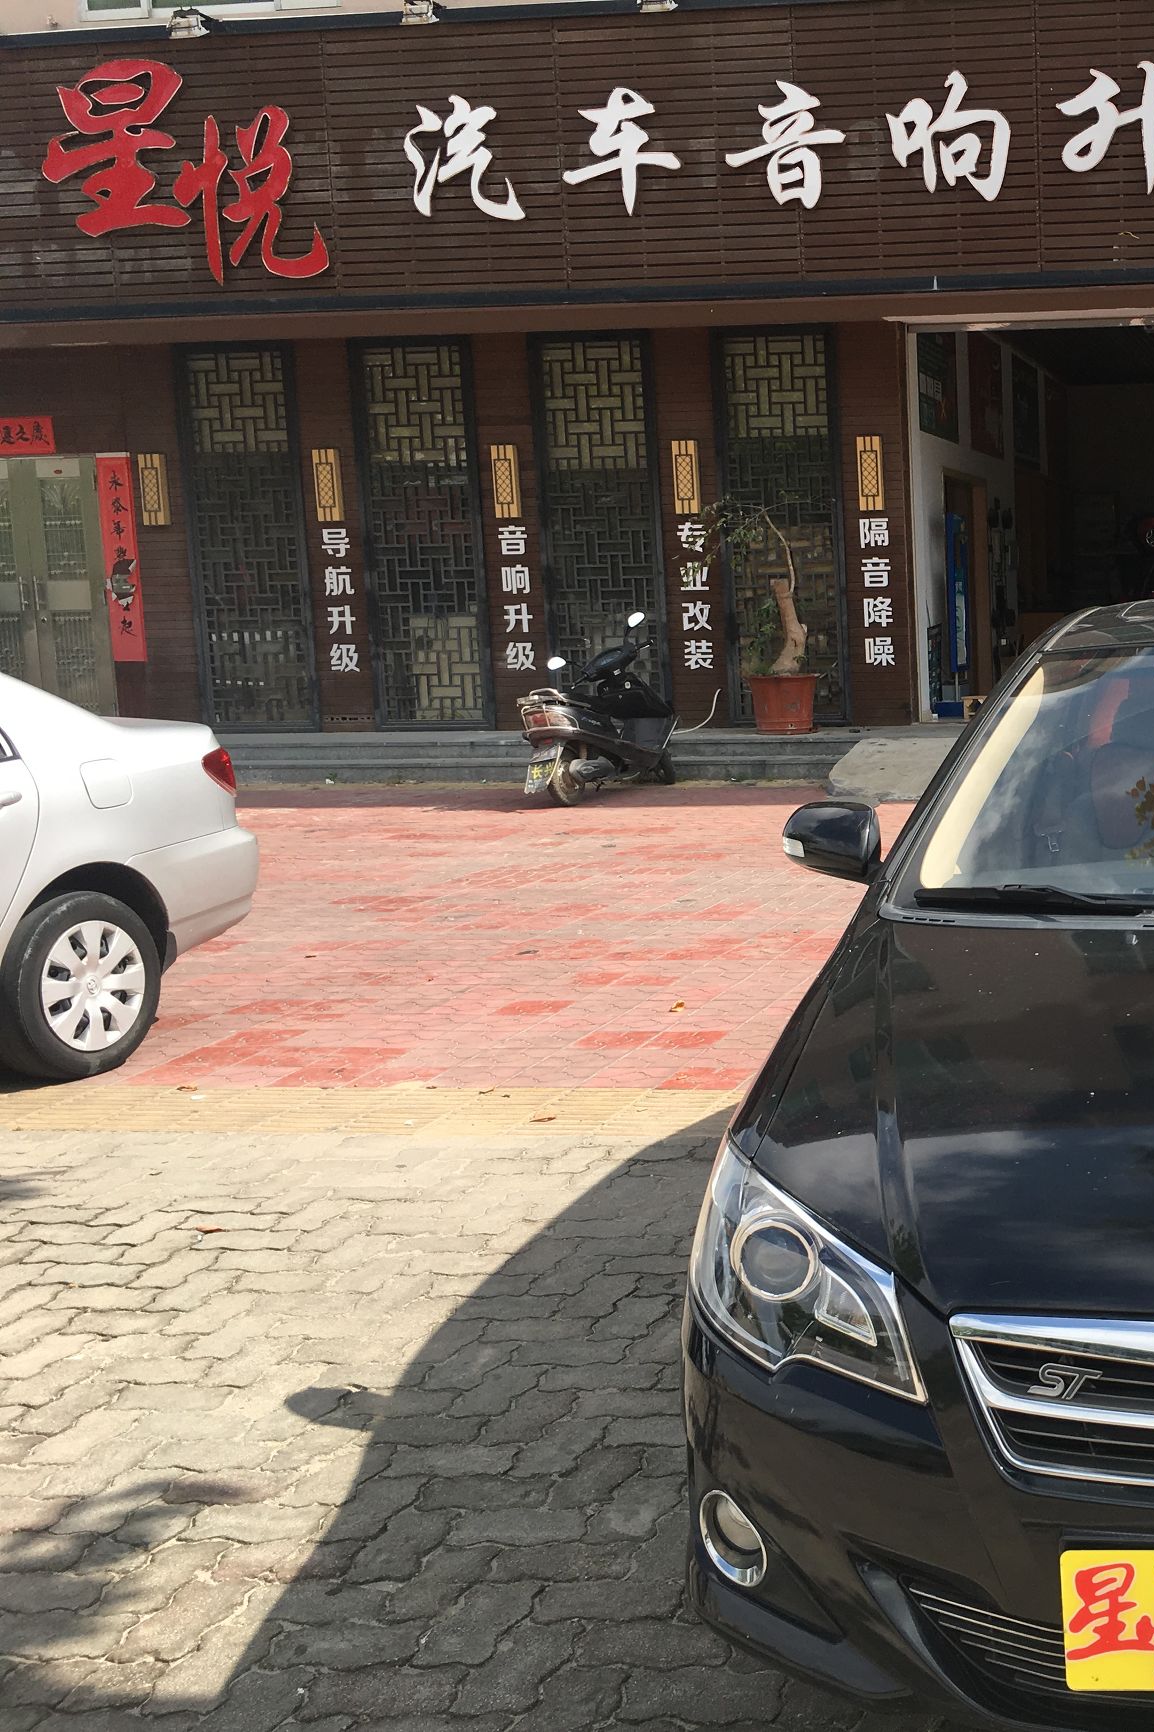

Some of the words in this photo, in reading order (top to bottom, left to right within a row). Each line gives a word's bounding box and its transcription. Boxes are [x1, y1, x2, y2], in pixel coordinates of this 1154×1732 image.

[41, 58, 330, 287] 星悦
[321, 527, 361, 674] 导航升级
[498, 525, 536, 672] 音响升级
[676, 521, 714, 670] 专业改装
[859, 517, 896, 667] 隔音降噪
[1026, 1362, 1103, 1400] ST
